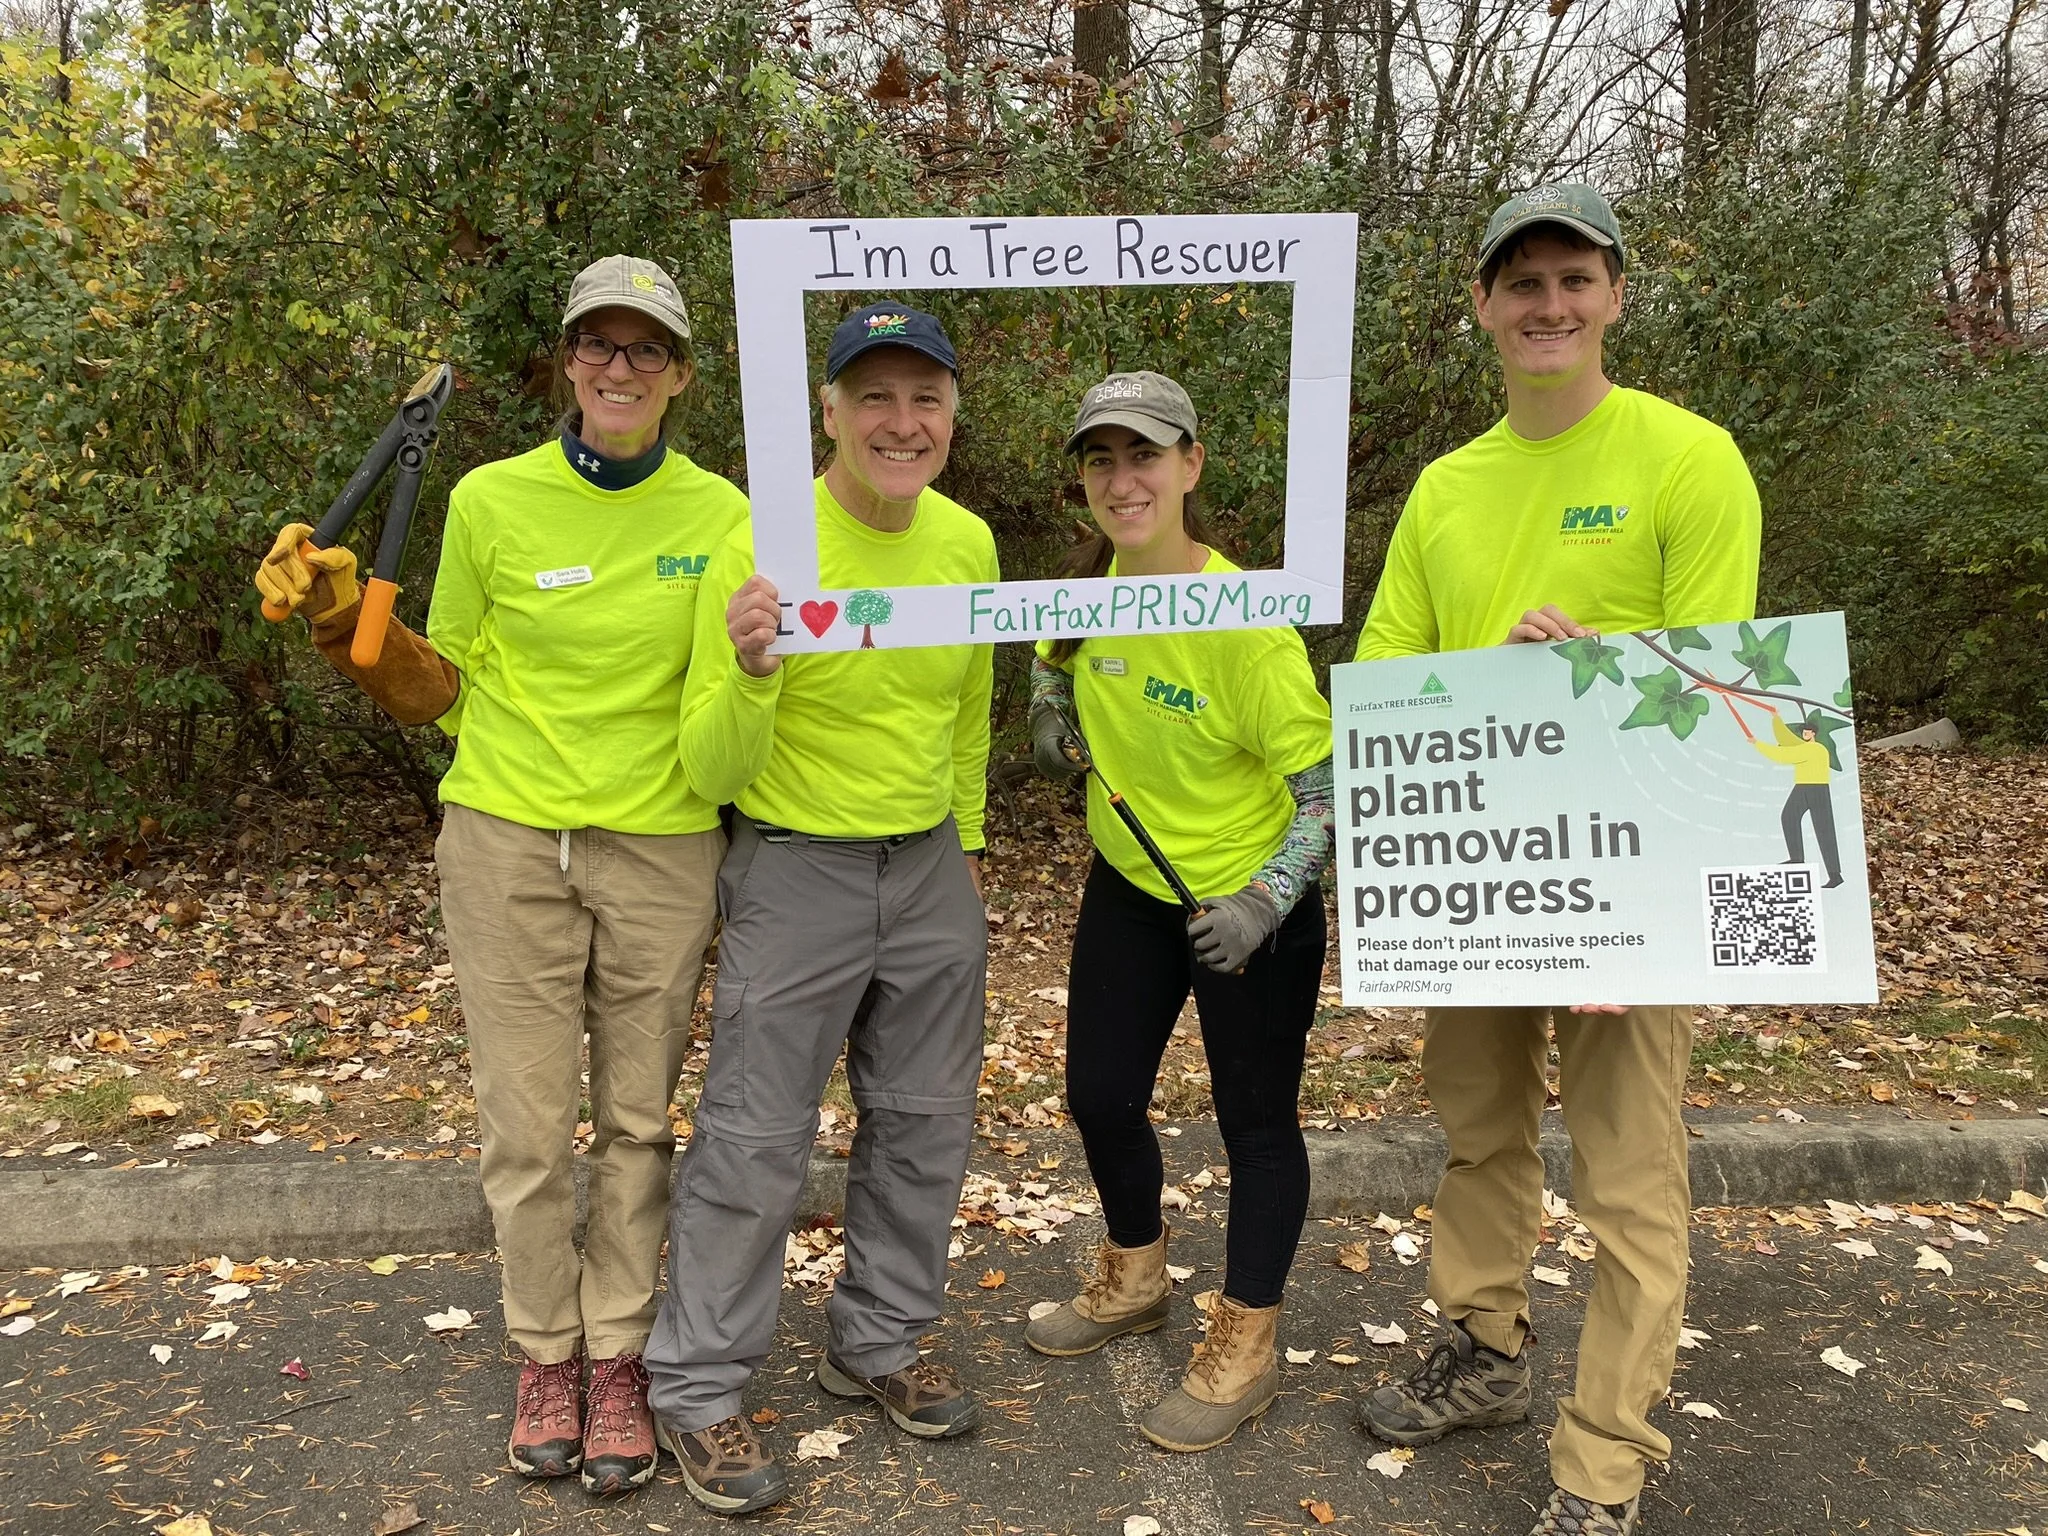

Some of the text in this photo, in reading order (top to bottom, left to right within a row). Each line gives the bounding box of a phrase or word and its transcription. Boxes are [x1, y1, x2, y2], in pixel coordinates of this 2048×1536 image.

[809, 217, 1301, 280] I'm a Tree Rescuer
[867, 325, 907, 338] AFAC
[1094, 390, 1142, 403] QUEEN
[1095, 383, 1142, 395] TRIVIA
[969, 580, 1312, 635] FairfaxPRISM.org
[1407, 694, 1453, 707] RESCUERS
[1348, 715, 1566, 770] Invasive
[1350, 769, 1486, 827] plant
[1351, 811, 1641, 869] removal in
[1354, 876, 1611, 928] progress.
[1357, 931, 1645, 952] Please don't plant invasive species
[1357, 956, 1591, 974] that damage our ecosystem.
[1358, 980, 1453, 995] FairfaxPRISM.org
